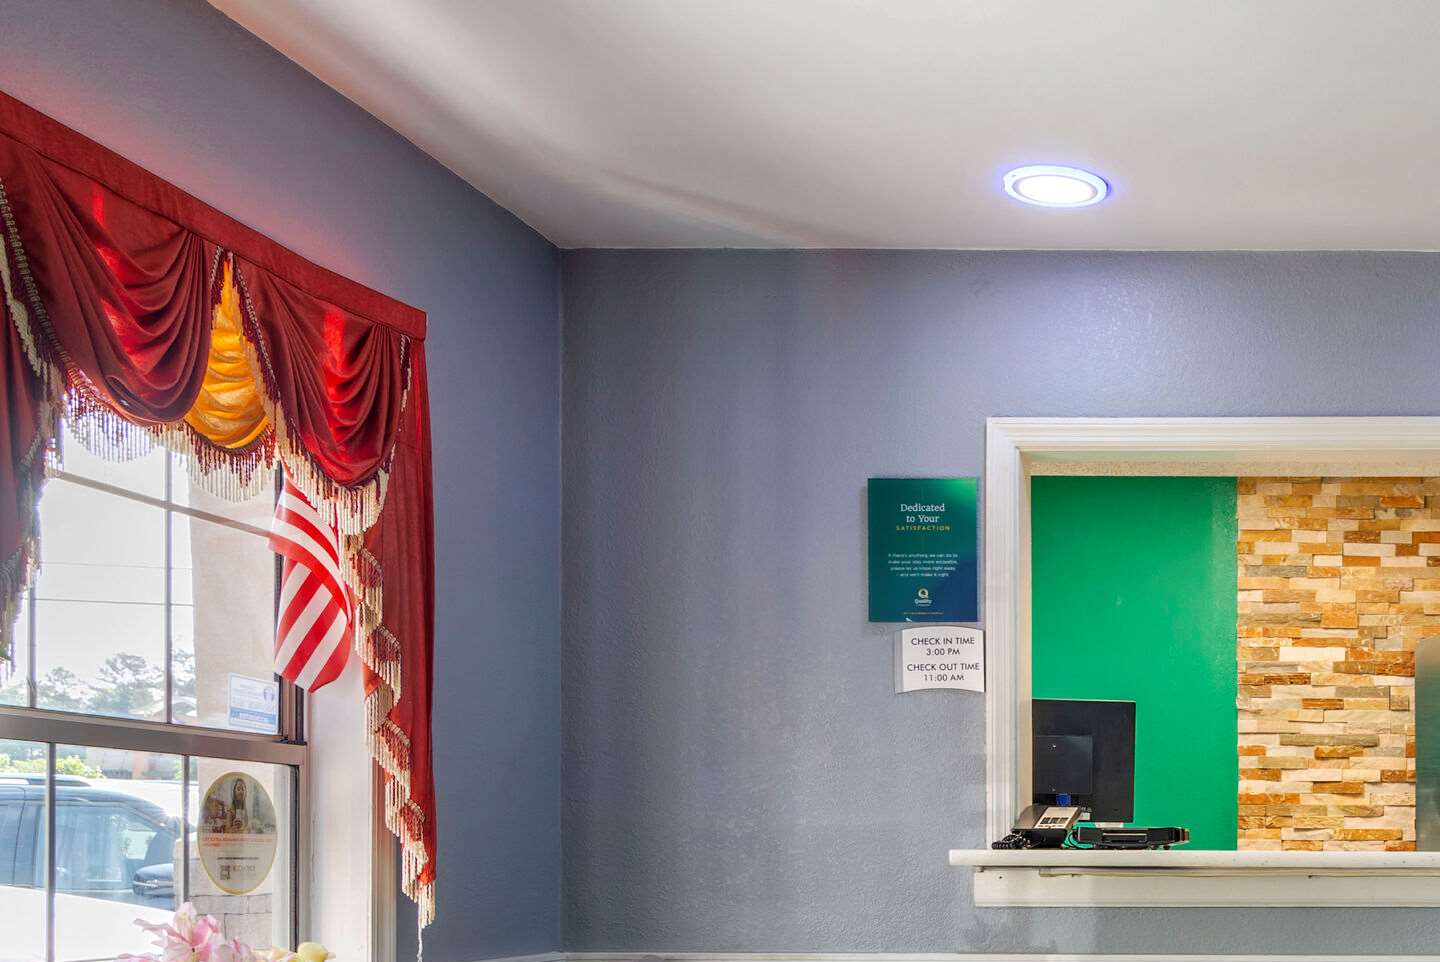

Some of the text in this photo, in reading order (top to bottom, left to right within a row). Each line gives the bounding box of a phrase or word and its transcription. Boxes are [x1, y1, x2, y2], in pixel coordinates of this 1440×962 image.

[911, 637, 975, 645] CHECK IN TIME
[907, 663, 980, 671] CHECK OUT TIME
